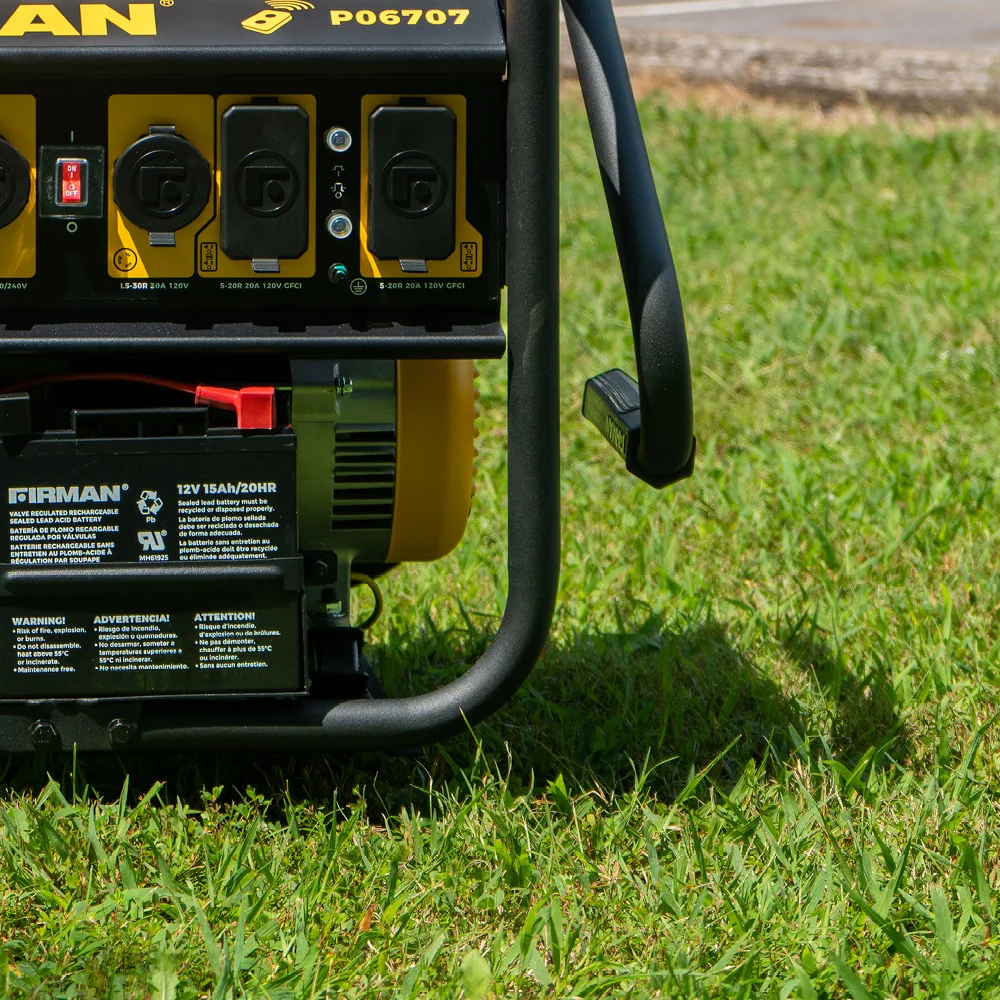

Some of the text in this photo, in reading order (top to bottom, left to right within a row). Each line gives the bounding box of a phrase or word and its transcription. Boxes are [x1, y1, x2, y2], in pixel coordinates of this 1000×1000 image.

[330, 9, 470, 26] P06707
[121, 282, 189, 290] L5-30R 30A 120V
[177, 482, 276, 494] 12V 15Ah/20HR
[8, 485, 121, 504] FIRMAN
[216, 499, 240, 507] battery
[43, 542, 95, 550] RECHARGEABLE
[12, 617, 65, 625] WARNING!
[94, 614, 169, 624] ADVERTENCIA!
[194, 613, 255, 621] ATTENTION!
